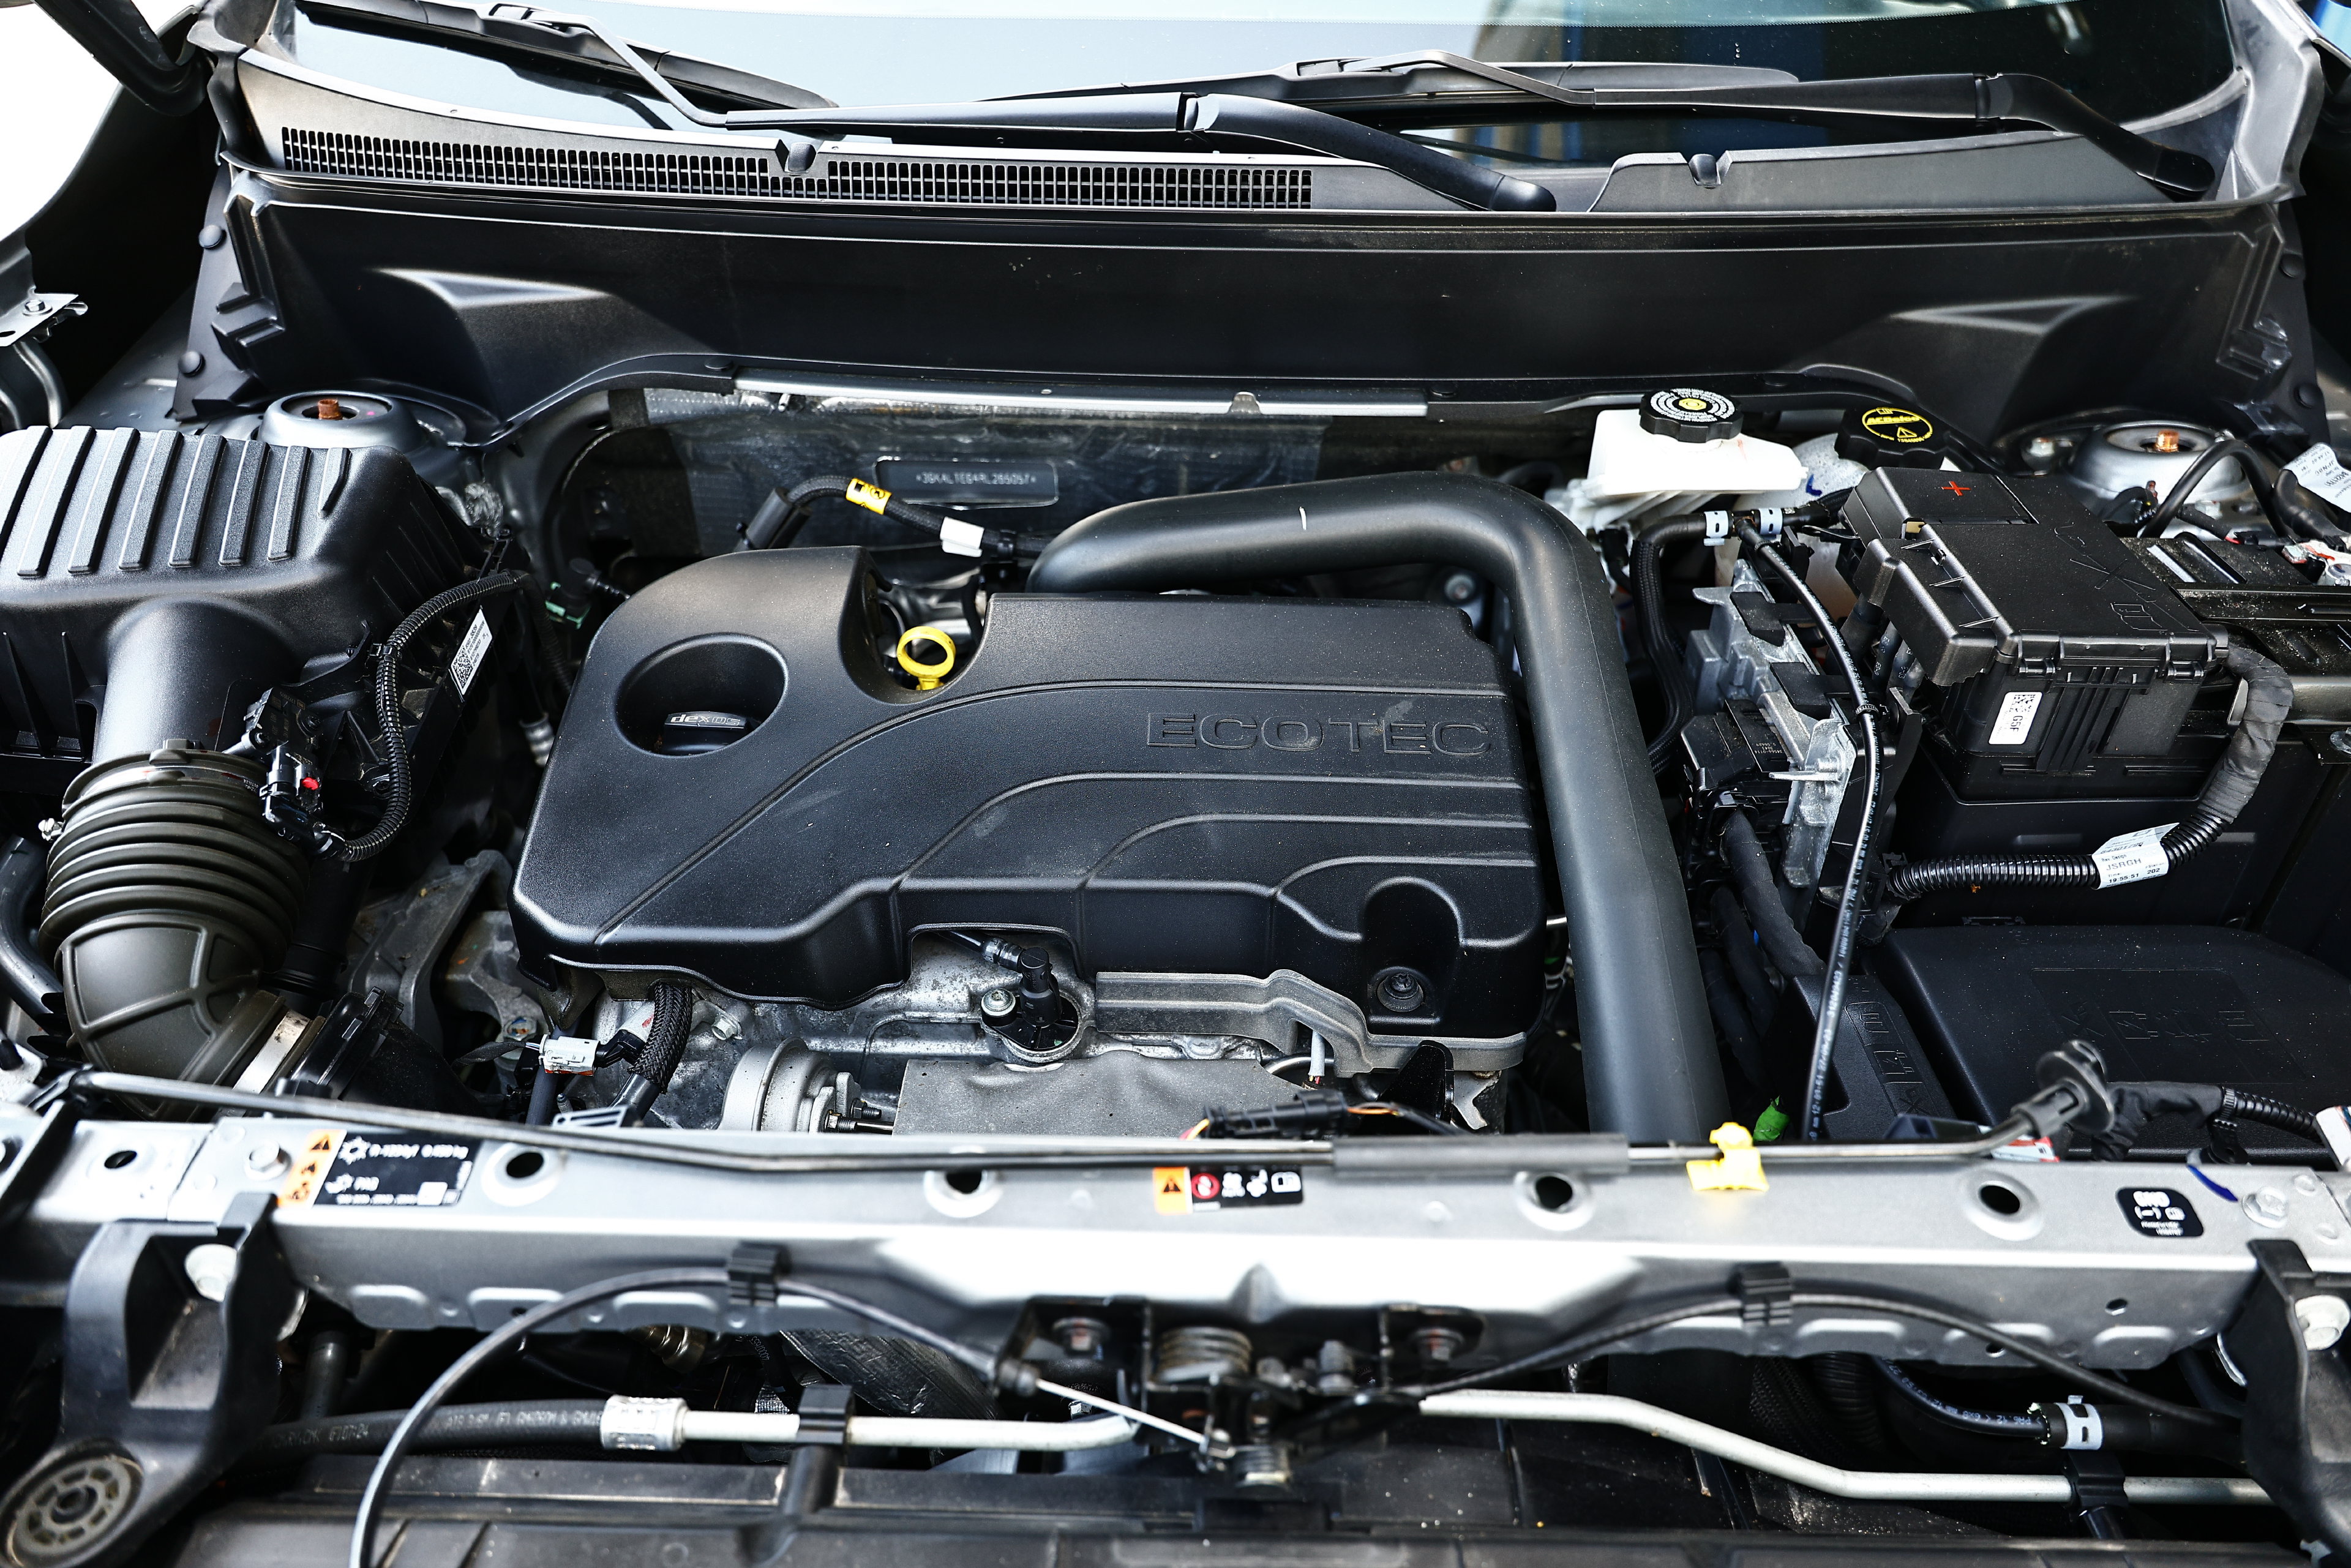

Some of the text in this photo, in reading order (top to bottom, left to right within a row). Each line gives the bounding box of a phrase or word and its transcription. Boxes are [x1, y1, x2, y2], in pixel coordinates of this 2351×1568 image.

[1867, 415, 1921, 424] ACDelco
[670, 714, 740, 726] dexos
[1147, 711, 1491, 757] ECOTEC
[2106, 858, 2142, 871] JSRGH
[2109, 873, 2139, 883] 19:55:51
